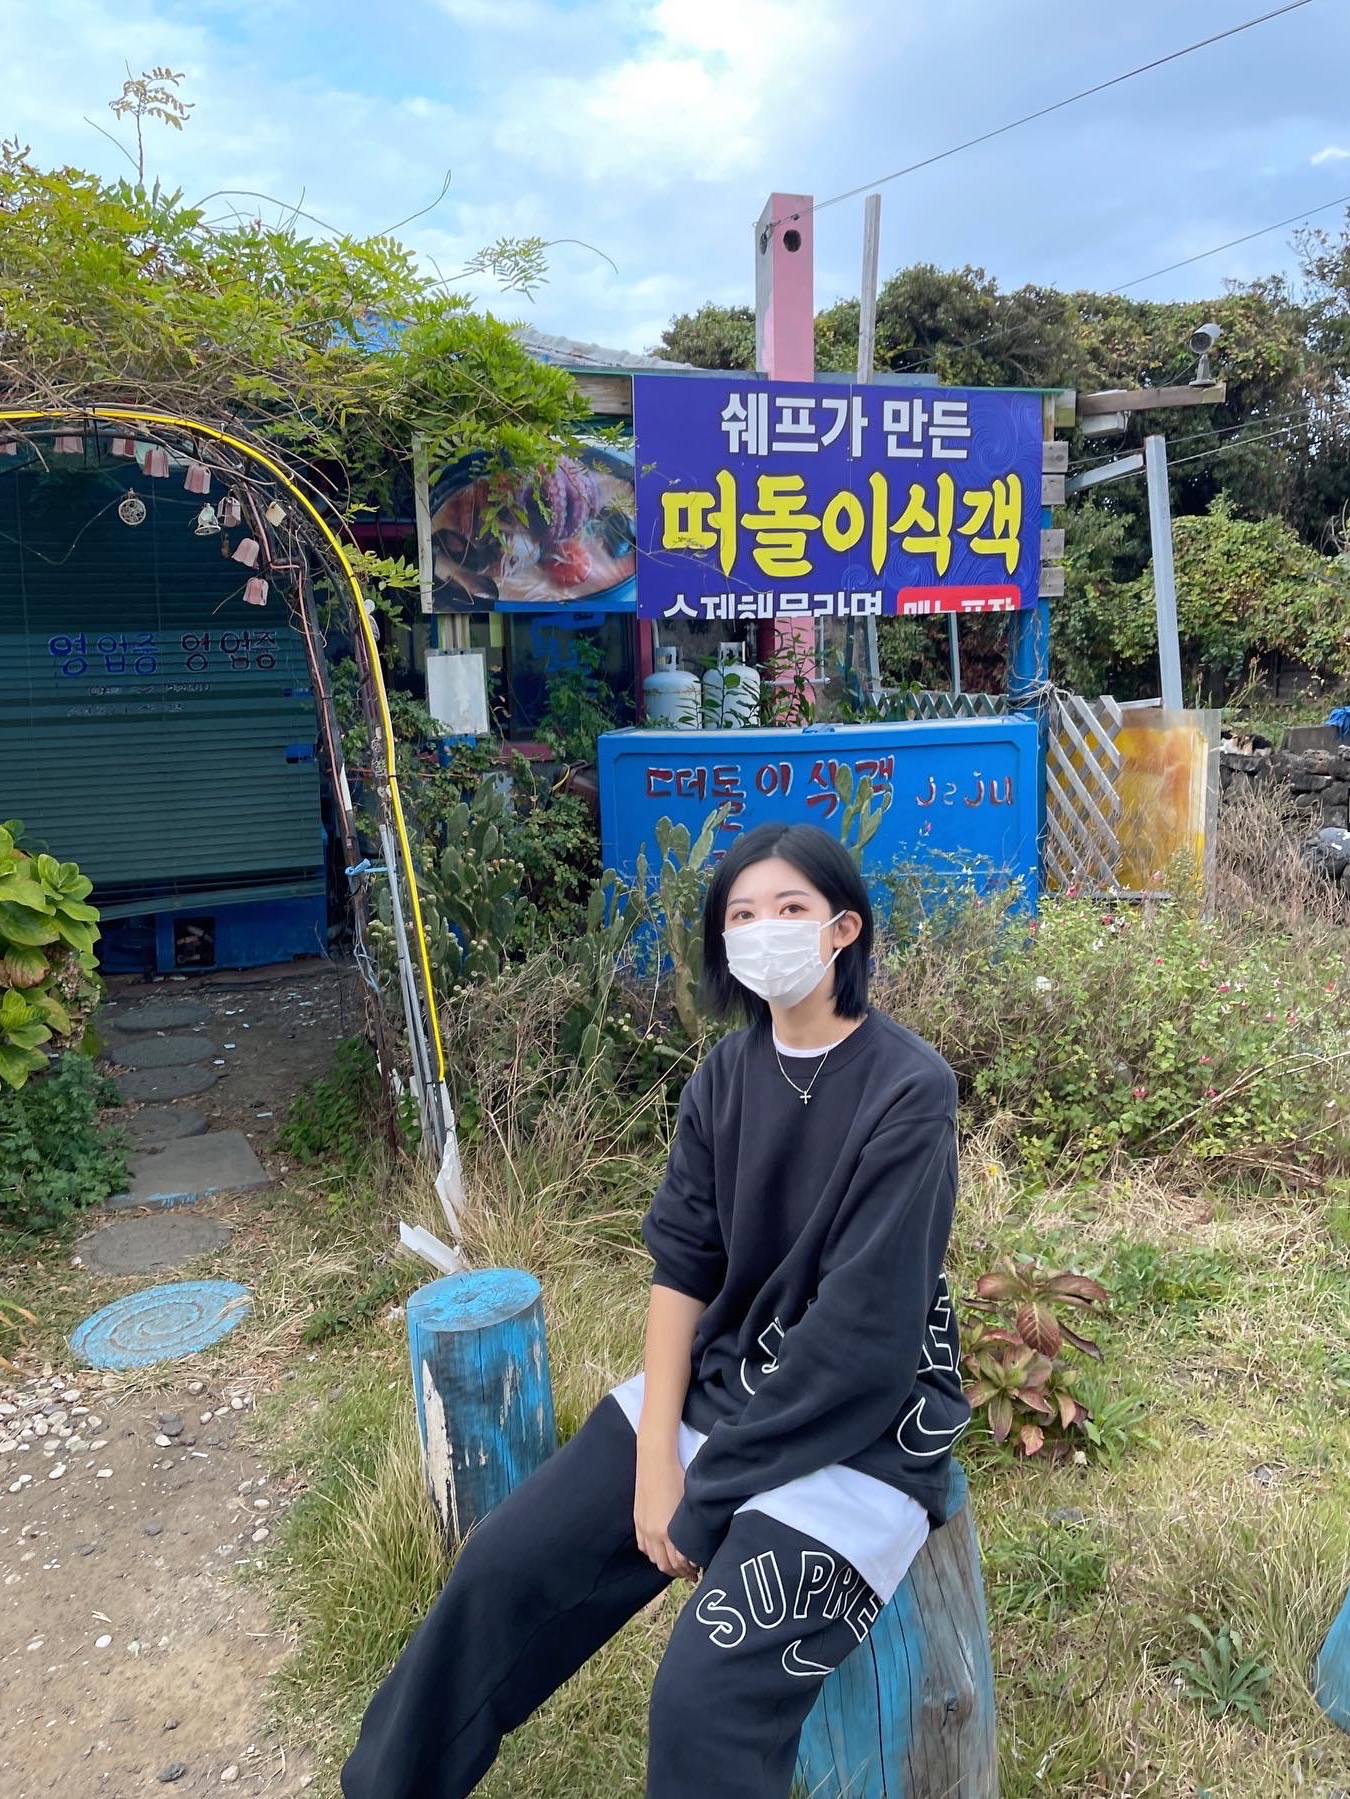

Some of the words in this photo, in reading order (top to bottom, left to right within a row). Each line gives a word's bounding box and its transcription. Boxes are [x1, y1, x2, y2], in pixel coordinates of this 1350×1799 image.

[720, 392, 869, 458] 쉐프가
[882, 398, 972, 459] 만든
[660, 468, 1023, 579] 떠돌이식객
